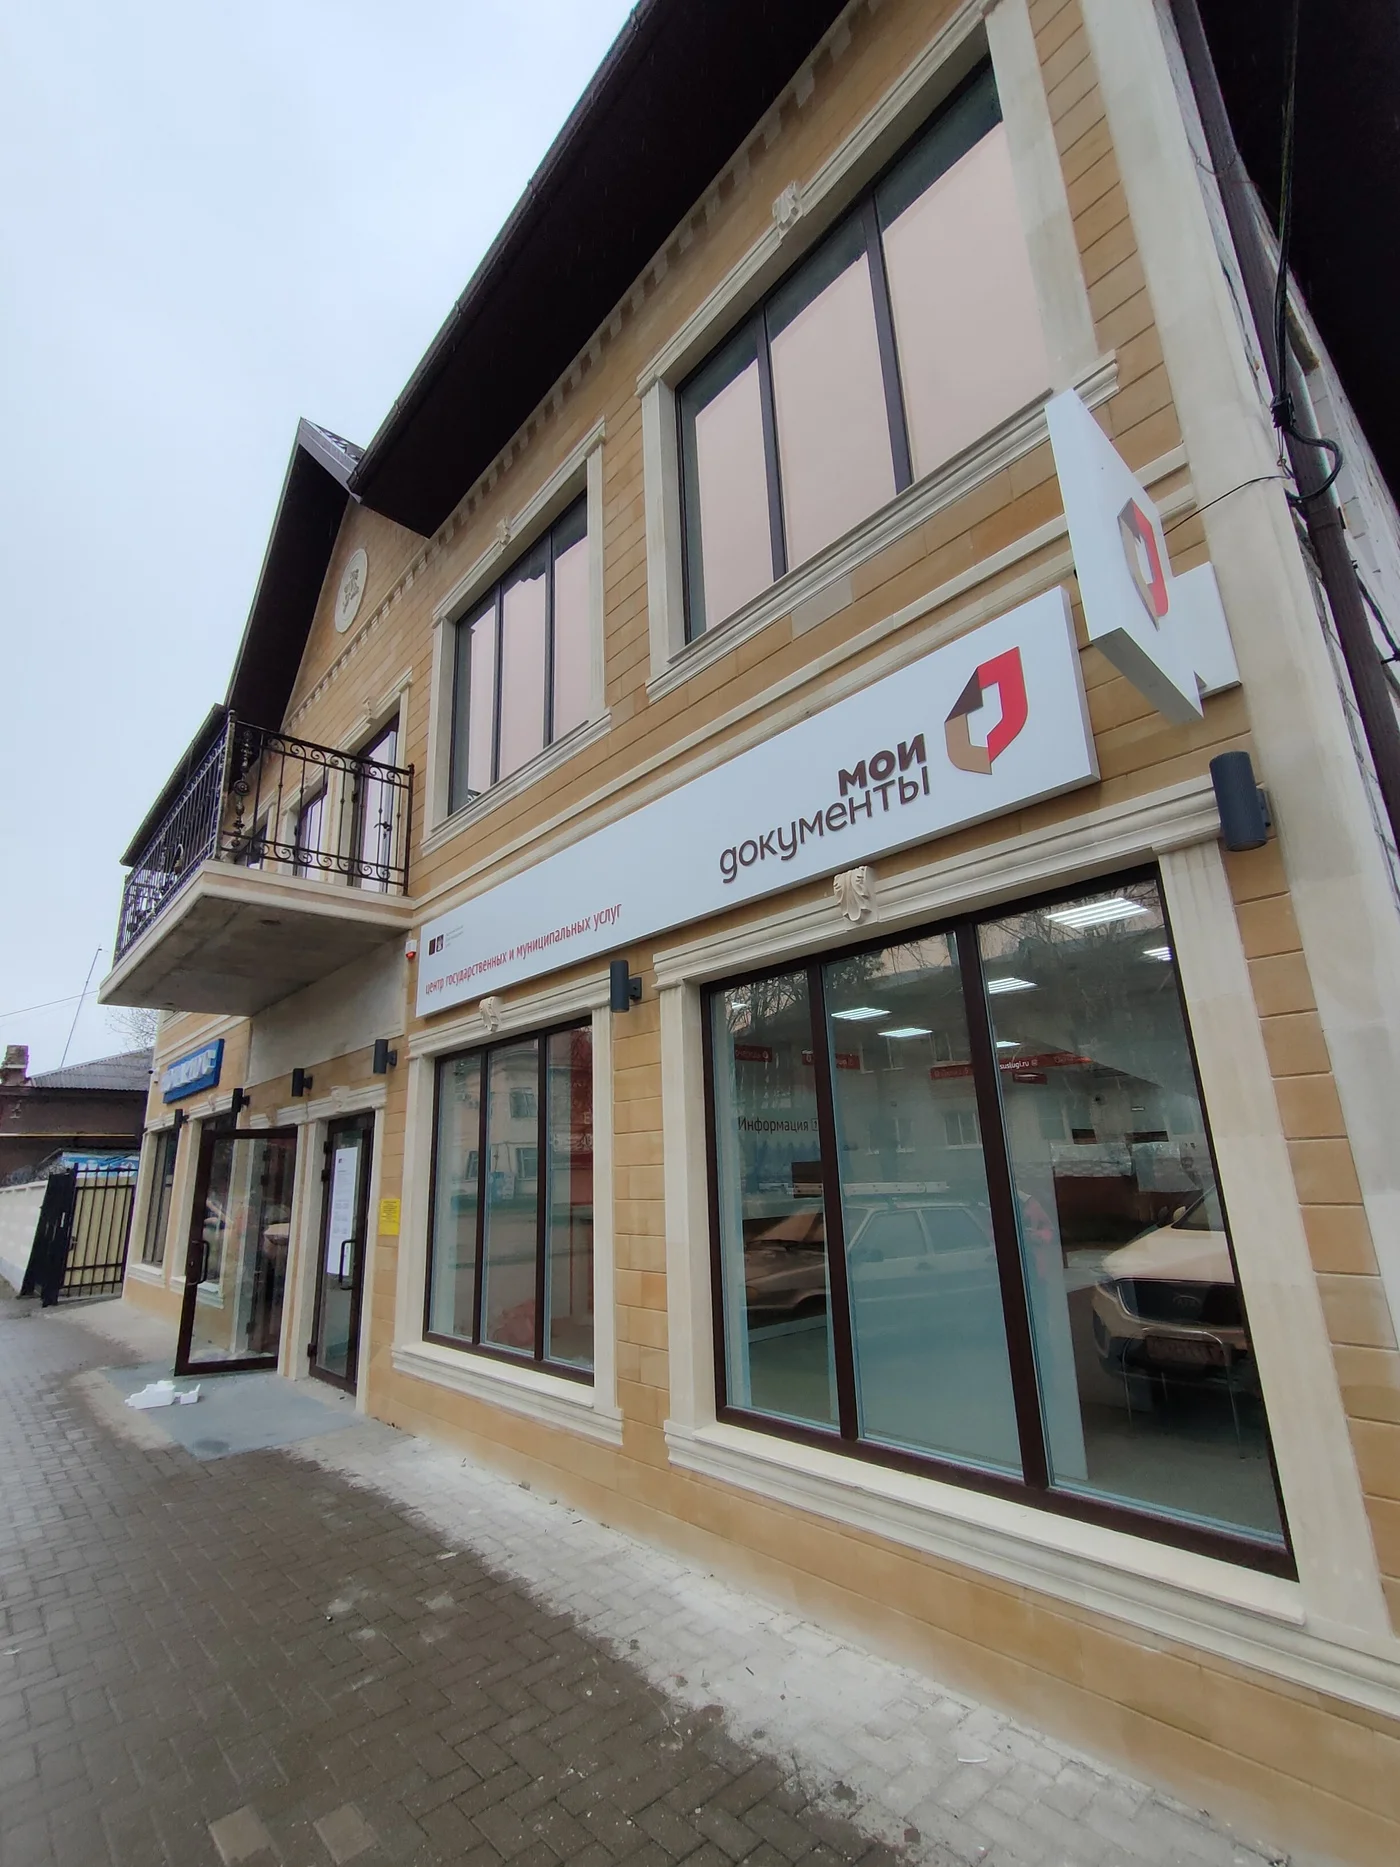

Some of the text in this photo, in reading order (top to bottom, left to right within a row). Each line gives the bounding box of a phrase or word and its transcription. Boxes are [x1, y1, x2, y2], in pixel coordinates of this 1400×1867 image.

[719, 766, 931, 884] документы
[425, 903, 622, 996] центр государственных и муниципальных услуг
[1000, 1060, 1030, 1070] suslugi.ru
[738, 1116, 809, 1134] Информация
